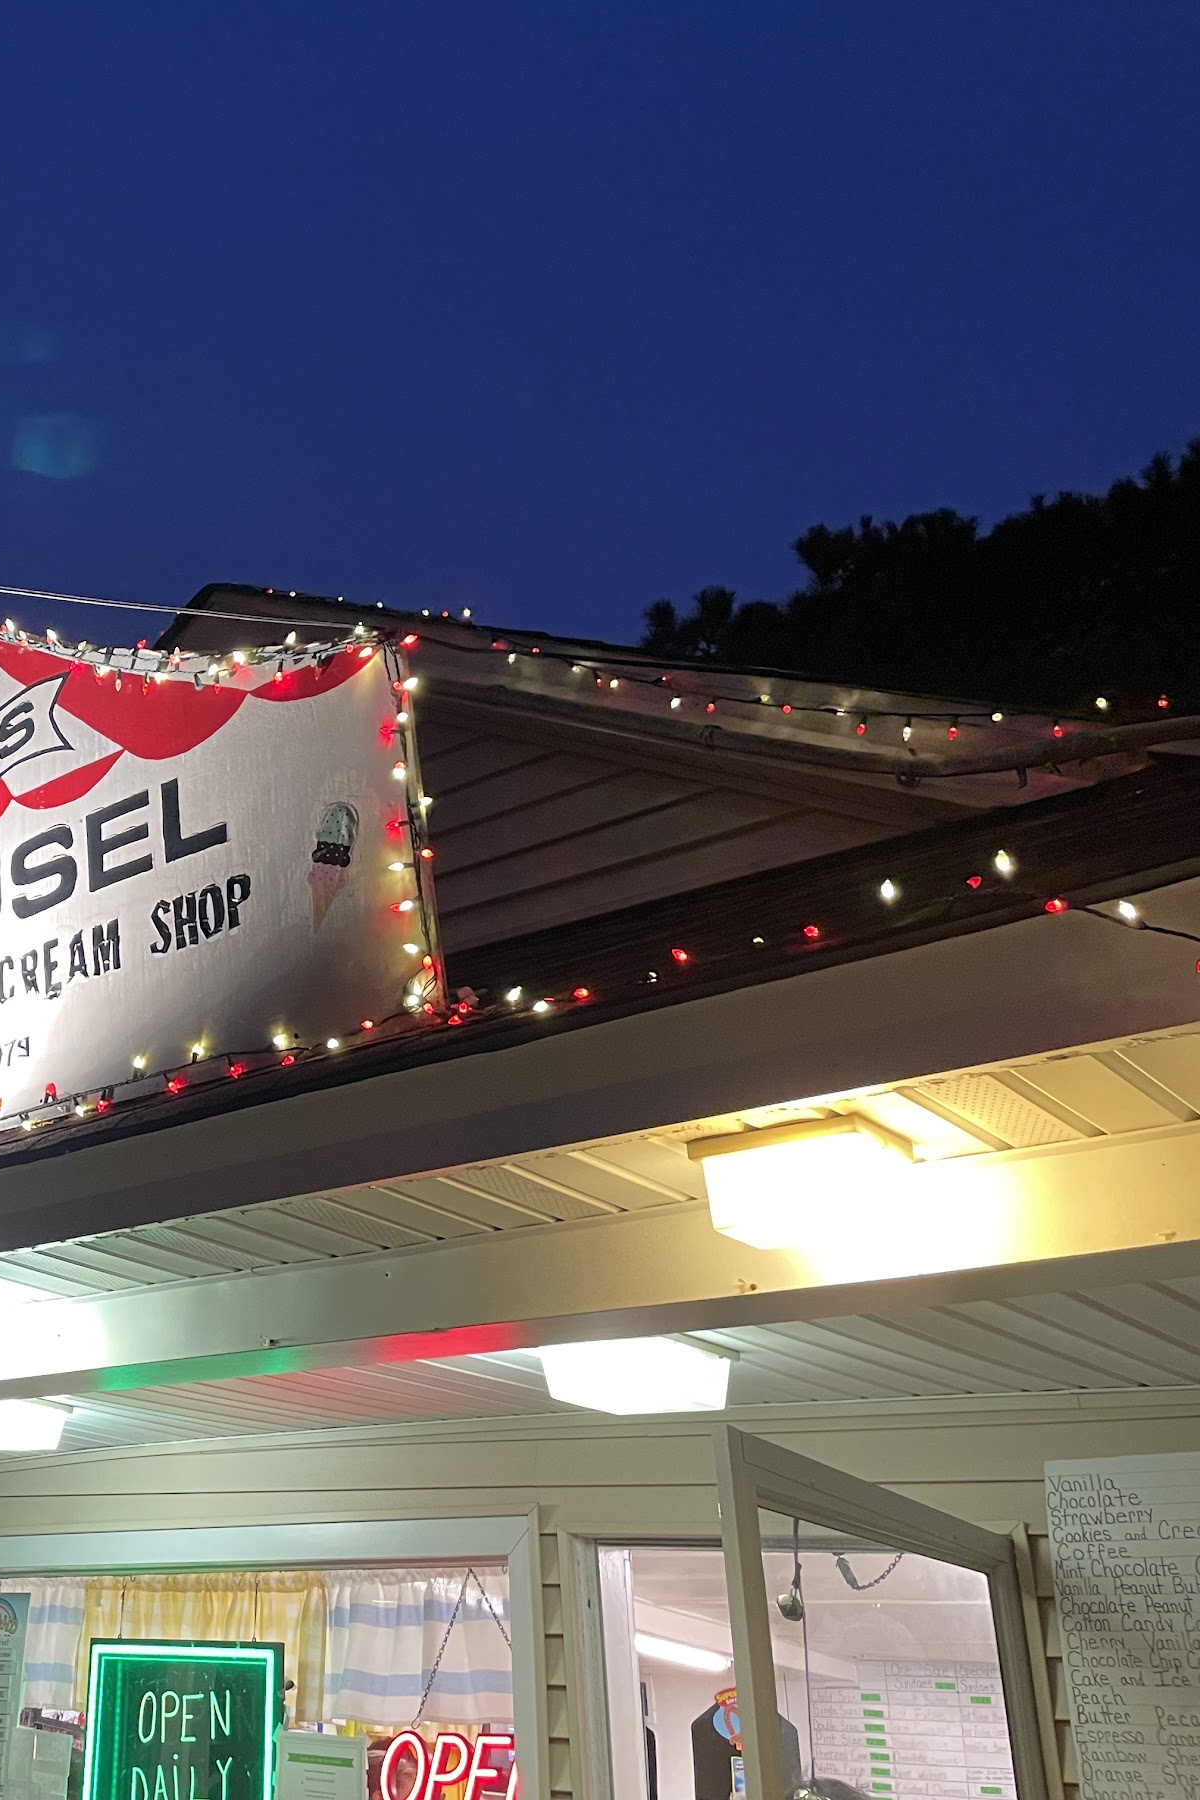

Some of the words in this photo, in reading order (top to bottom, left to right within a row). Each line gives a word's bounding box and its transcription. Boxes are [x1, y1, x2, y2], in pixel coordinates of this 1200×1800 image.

[150, 873, 252, 955] SHOP
[1048, 1474, 1118, 1493] Vanilla
[1047, 1489, 1142, 1510] Chocolate
[1051, 1507, 1153, 1527] Strawberry
[1052, 1525, 1112, 1544] Cookies
[1125, 1525, 1147, 1541] and
[1057, 1543, 1131, 1561] Coffee
[1055, 1559, 1086, 1579] Mint
[1091, 1557, 1180, 1579] Chocolate
[1054, 1578, 1101, 1596] Vanilla
[1113, 1577, 1164, 1596] Peanut
[1060, 1594, 1136, 1615] Chocolate
[1143, 1594, 1194, 1614] Peanut
[1062, 1614, 1111, 1632] Cotton
[1121, 1612, 1174, 1633] Candy
[1067, 1632, 1126, 1650] Cherry
[1141, 1631, 1200, 1651] Vanilla
[1068, 1649, 1143, 1668] Chocolate
[1150, 1649, 1182, 1673] Chip
[1071, 1669, 1111, 1688] Cake
[1121, 1671, 1145, 1687] and
[1153, 1670, 1192, 1687] Ice
[1072, 1685, 1127, 1705] Peach
[138, 1689, 232, 1744] OPEN
[1077, 1704, 1132, 1725] Butter
[1074, 1725, 1145, 1744] Espresso
[1079, 1743, 1148, 1763] Rainbow
[381, 1731, 517, 1800] OPE
[1082, 1761, 1144, 1782] Orange
[131, 1753, 233, 1800] DAILY
